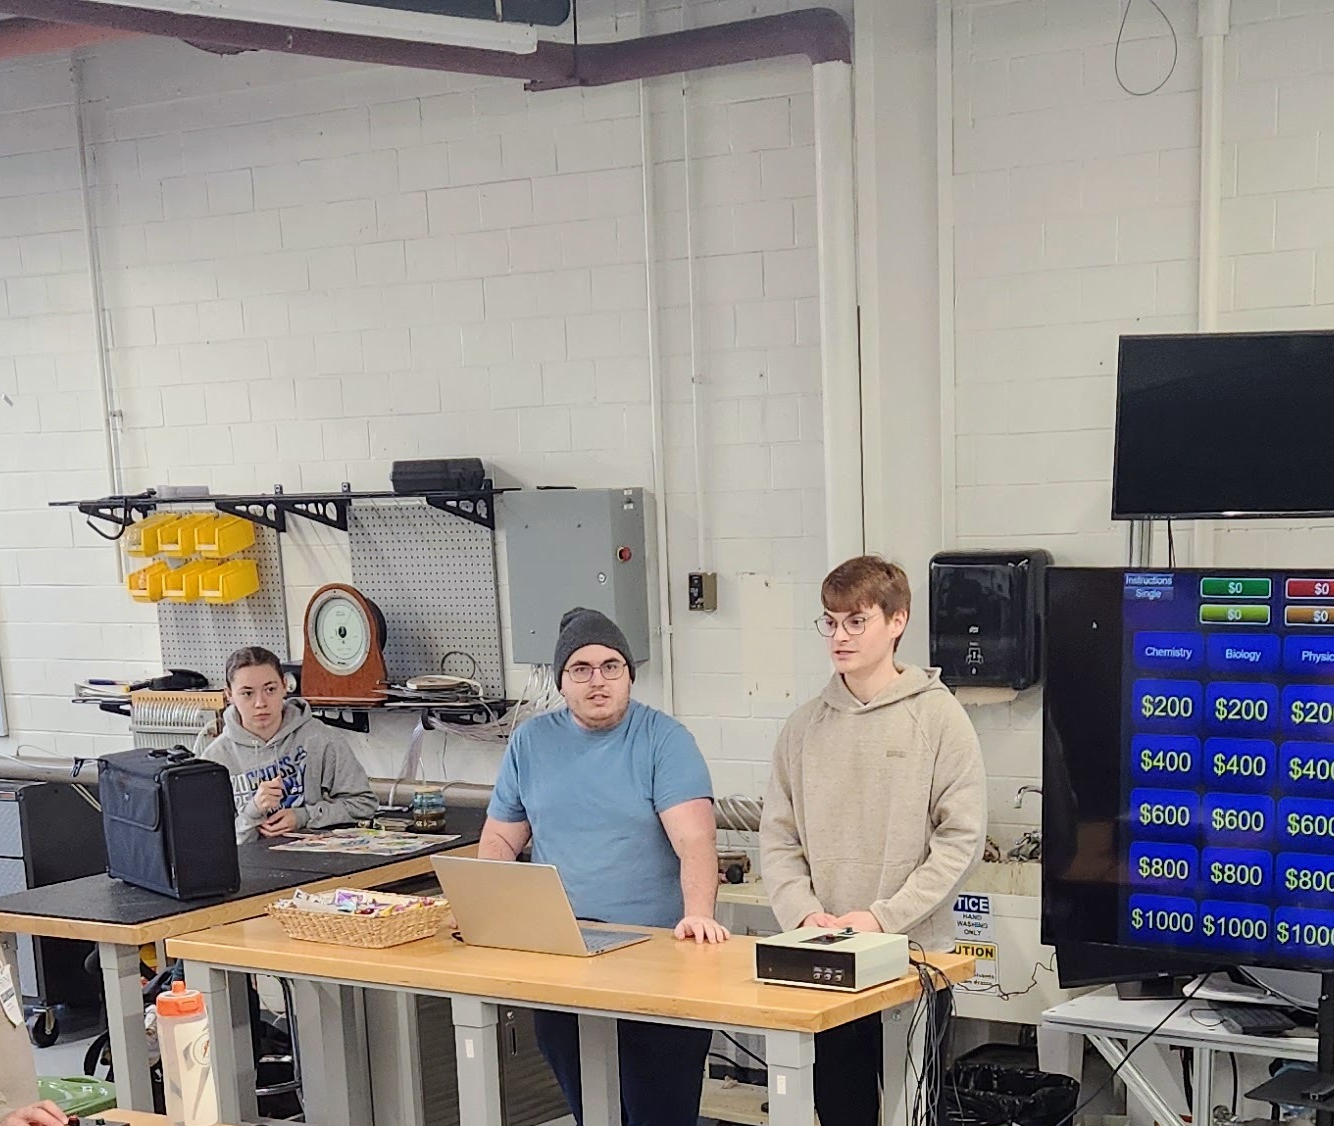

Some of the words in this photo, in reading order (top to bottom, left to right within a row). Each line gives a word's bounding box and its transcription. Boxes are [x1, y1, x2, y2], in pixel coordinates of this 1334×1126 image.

[1125, 575, 1172, 586] Instructions
[1135, 589, 1161, 600] Single
[1228, 582, 1243, 595] $0
[1314, 583, 1330, 596] $0
[1227, 609, 1242, 621] $0
[1313, 610, 1329, 623] $0
[1145, 646, 1193, 660] Chemistry
[1225, 649, 1262, 662] Biology
[1141, 694, 1193, 718] $200
[1214, 697, 1268, 721] $200
[1140, 749, 1192, 772] $400
[1213, 752, 1266, 776] $400
[1139, 802, 1190, 827] $600
[1211, 807, 1264, 832] $600
[1138, 856, 1189, 880] $800
[1210, 861, 1262, 886] $800
[957, 896, 989, 912] TICE
[957, 920, 988, 929] WASHING
[962, 913, 982, 921] HAND
[1131, 907, 1194, 933] $1000
[1202, 914, 1267, 940] $1000
[954, 945, 994, 959] UTION
